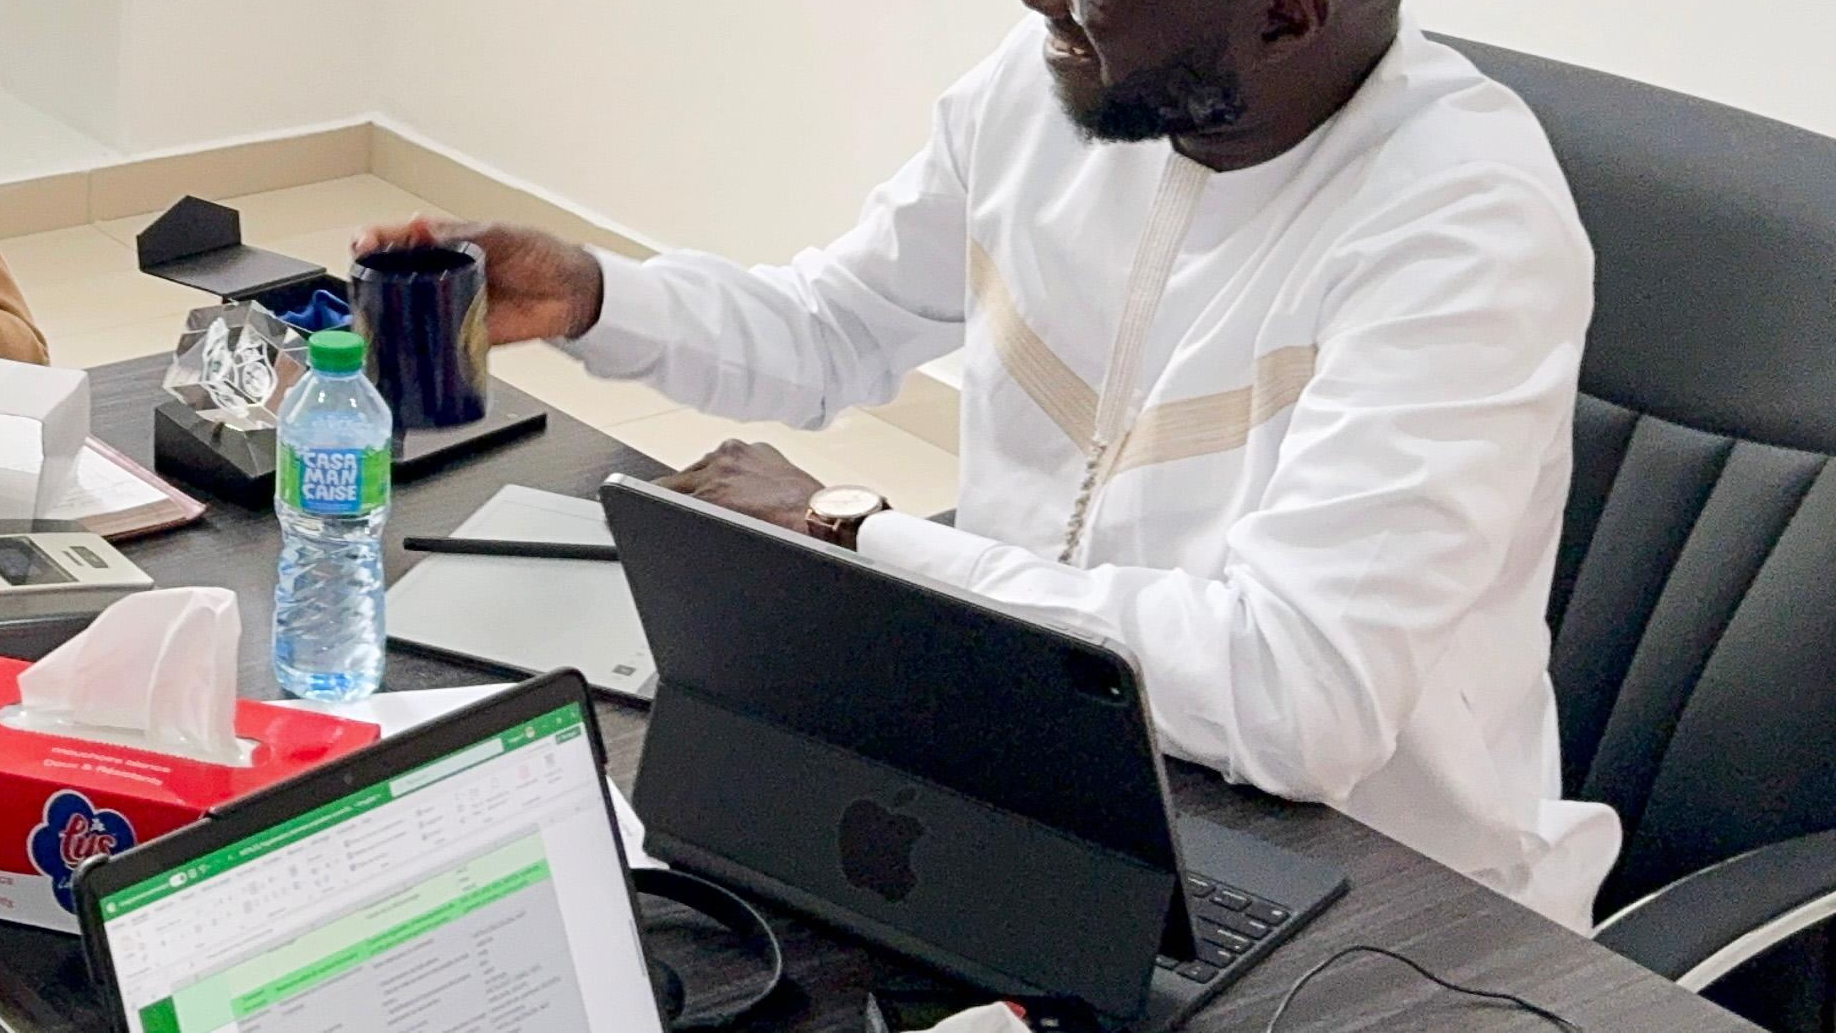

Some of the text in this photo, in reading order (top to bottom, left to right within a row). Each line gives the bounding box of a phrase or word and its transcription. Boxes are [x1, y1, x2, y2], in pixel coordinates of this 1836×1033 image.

[303, 452, 357, 469] CASA
[304, 468, 357, 485] MAN
[302, 484, 357, 500] CAISE
